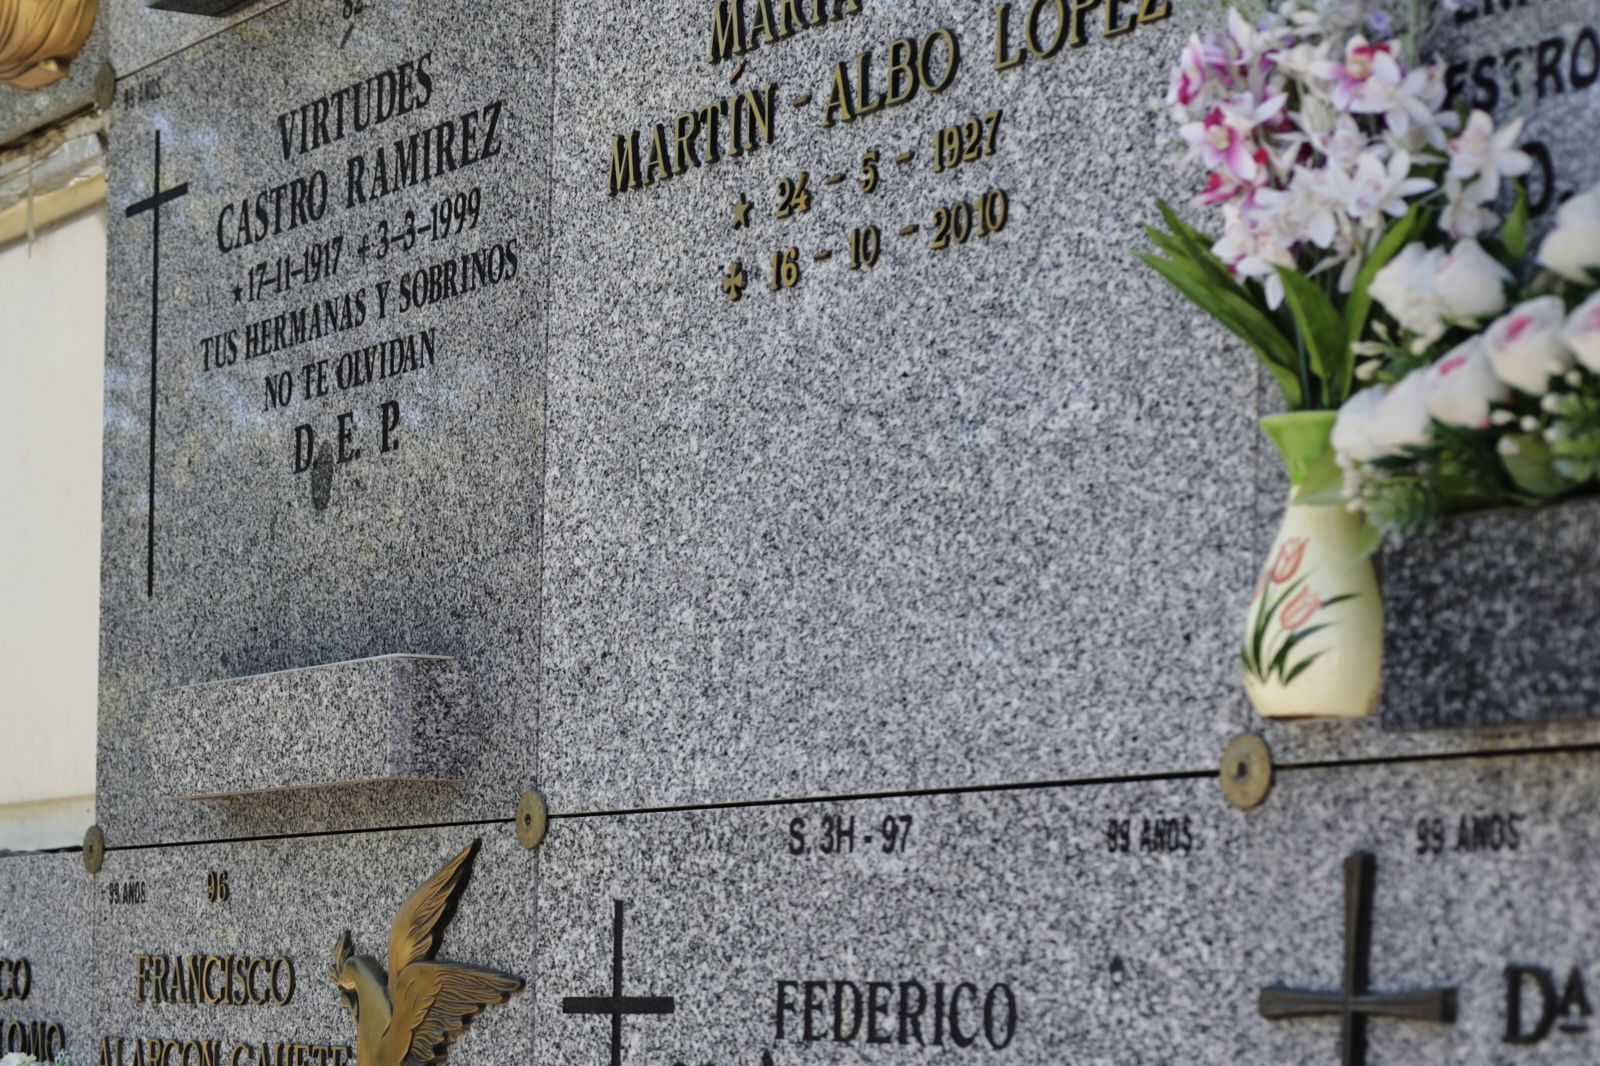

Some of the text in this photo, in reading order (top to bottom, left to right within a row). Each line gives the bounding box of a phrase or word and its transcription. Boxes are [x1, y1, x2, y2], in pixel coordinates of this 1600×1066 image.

[278, 53, 432, 160] VIRTUDES
[931, 109, 1003, 173] 1927
[217, 101, 502, 253] CASTRO RAMIREZ
[930, 188, 1008, 250] 2010
[201, 238, 518, 371] TUS HERMANAS Y SOBRINOS
[264, 328, 436, 412] NO TE OLVIDAN
[788, 816, 811, 856] S.
[820, 815, 855, 855] 3H
[882, 815, 913, 855] 97
[208, 870, 229, 903] 96
[135, 954, 296, 1006] FRANCISCO
[775, 979, 1018, 1050] FEDERICO
